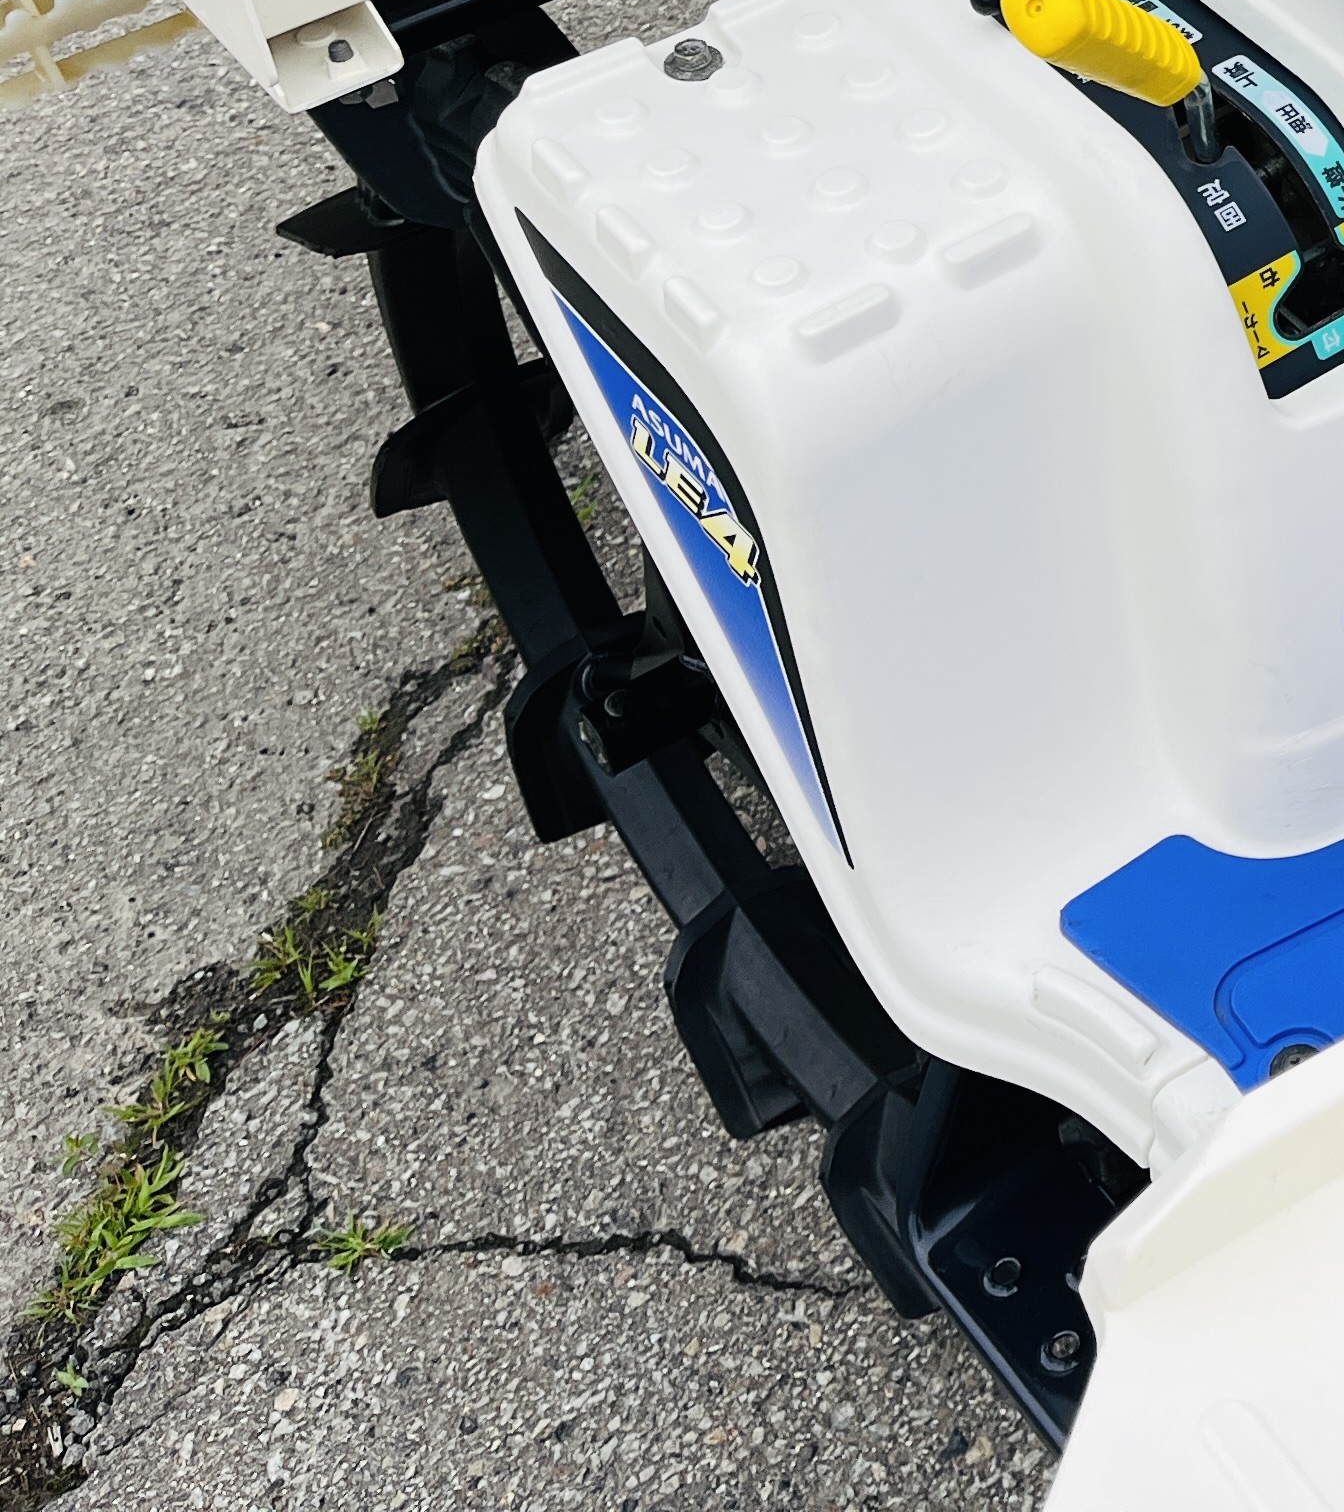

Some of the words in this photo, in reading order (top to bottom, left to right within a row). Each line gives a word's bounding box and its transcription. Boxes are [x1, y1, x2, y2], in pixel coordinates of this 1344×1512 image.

[1222, 61, 1258, 89] 上昇
[1276, 103, 1313, 135] 油圧
[1197, 178, 1247, 232] 固定
[1259, 267, 1281, 289] 右
[1241, 299, 1271, 358] マーカー
[631, 393, 727, 503] ASUMA
